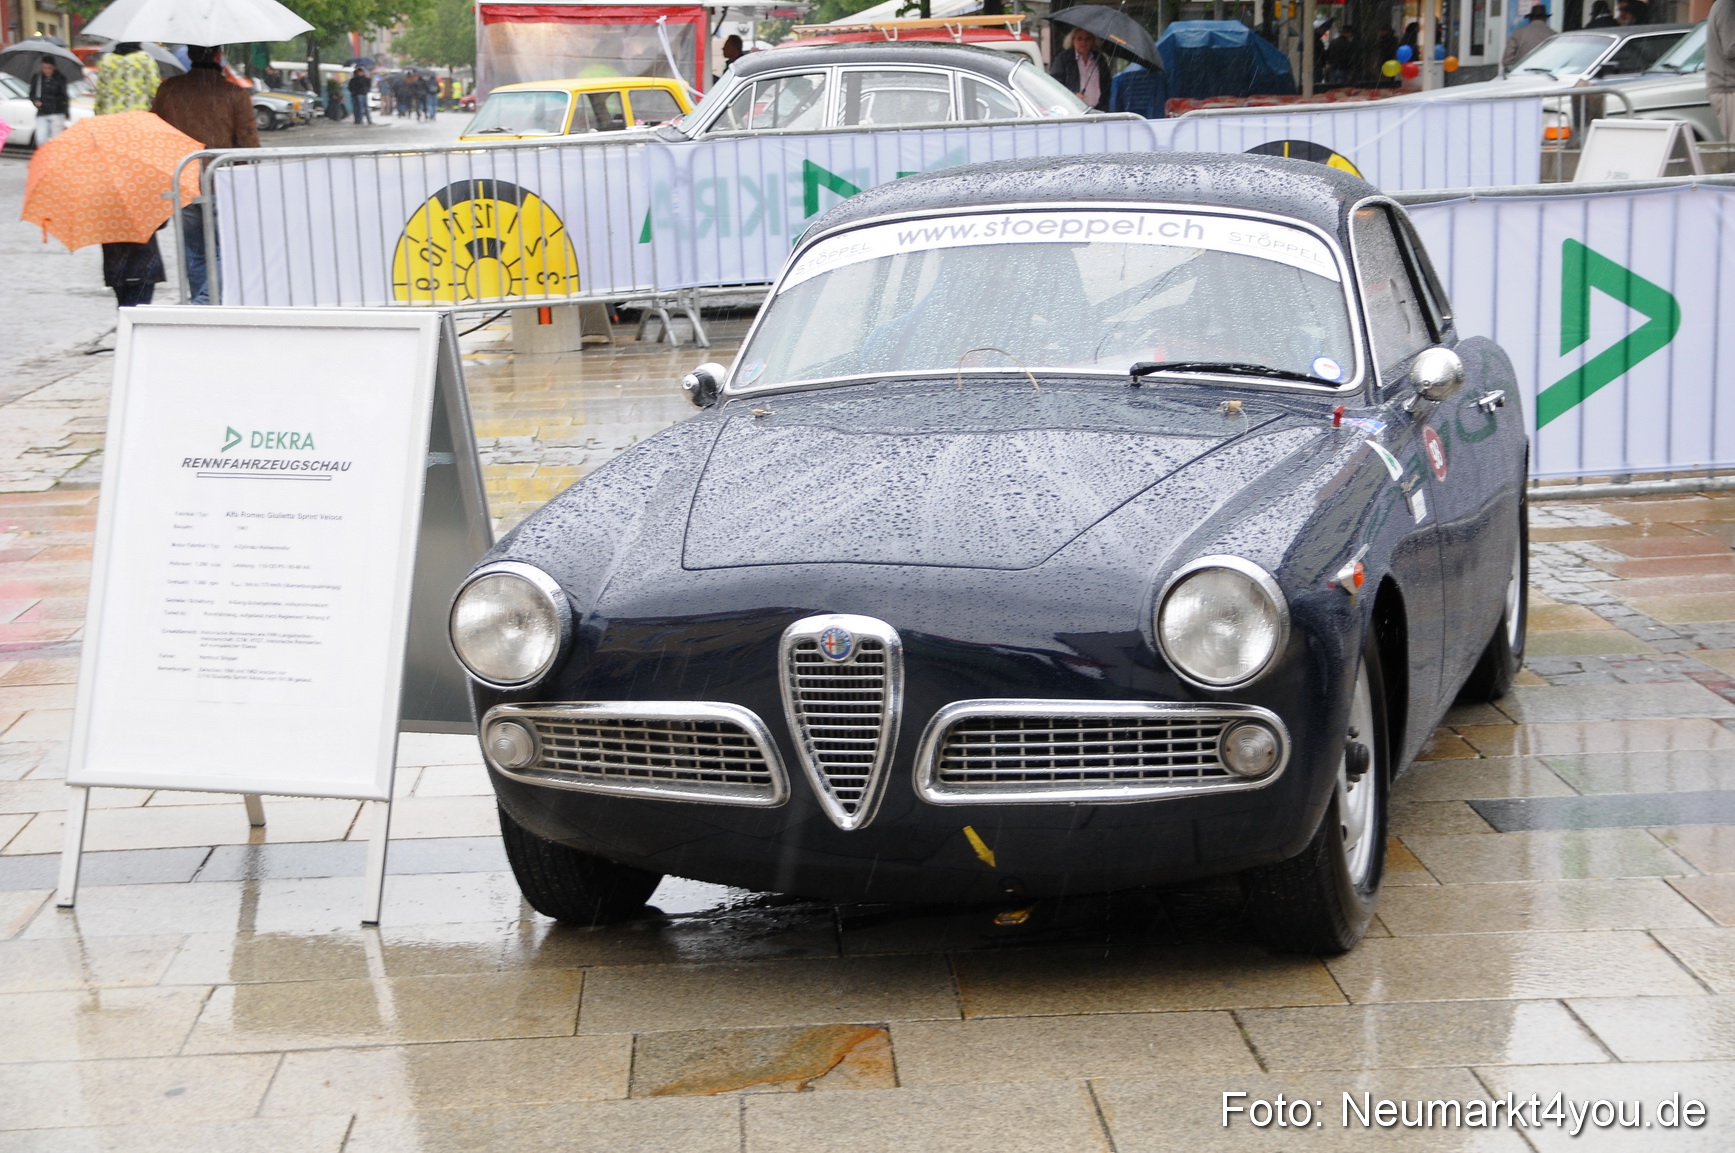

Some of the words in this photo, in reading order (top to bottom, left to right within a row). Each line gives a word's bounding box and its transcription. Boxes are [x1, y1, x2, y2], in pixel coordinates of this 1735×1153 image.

[897, 215, 1205, 247] www.stoeppel.ch
[1228, 230, 1326, 264] STÖPPEL
[250, 430, 316, 451] DEKRA
[181, 457, 352, 472] RENNFAHRZEUGSCHAU
